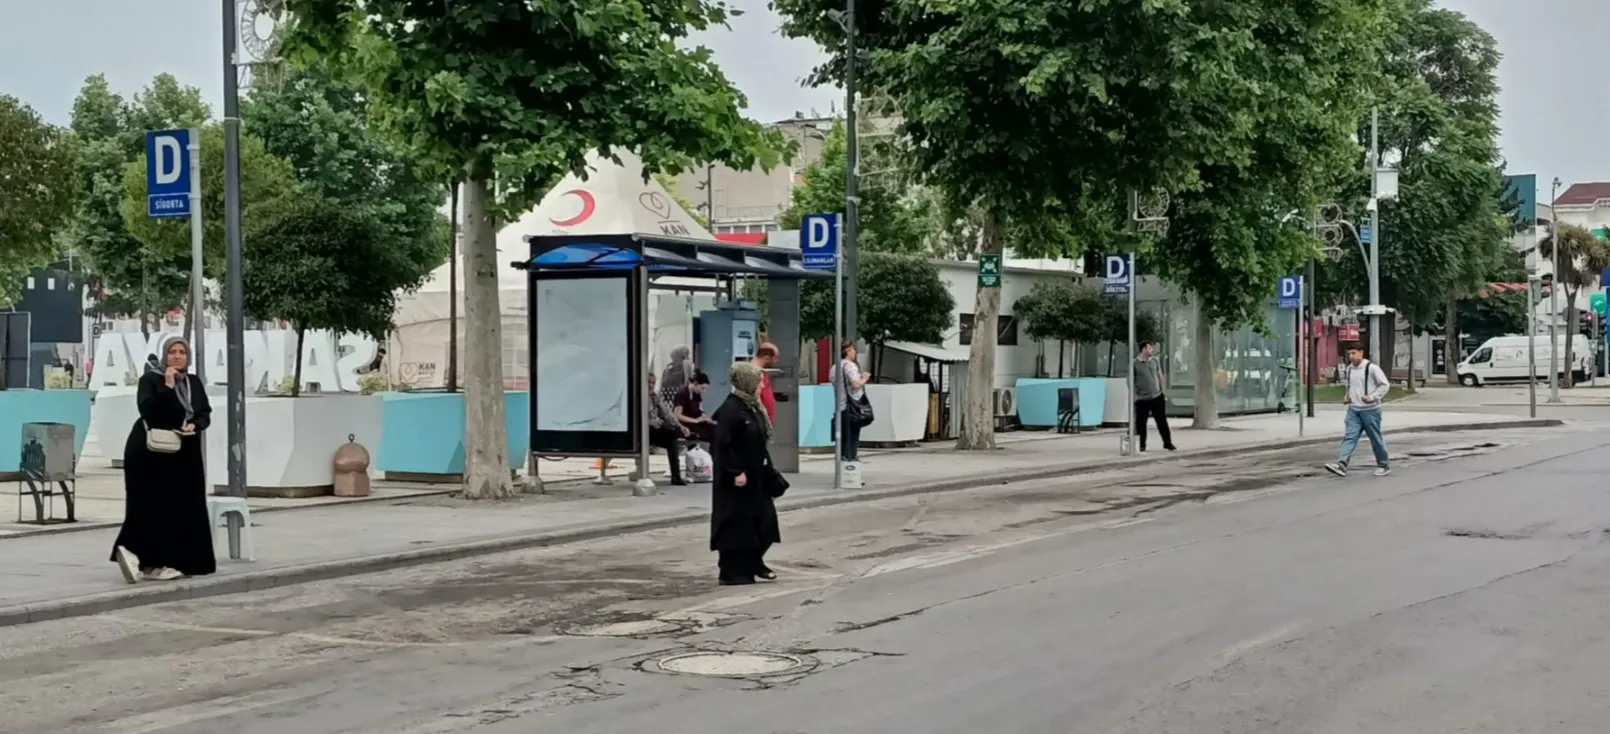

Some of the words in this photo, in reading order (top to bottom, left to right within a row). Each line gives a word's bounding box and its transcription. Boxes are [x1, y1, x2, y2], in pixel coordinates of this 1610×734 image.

[155, 135, 182, 184] D
[659, 224, 690, 237] KAN
[808, 217, 829, 248] D
[1107, 256, 1125, 278] D
[1282, 278, 1295, 296] D
[419, 362, 436, 370] KAN
